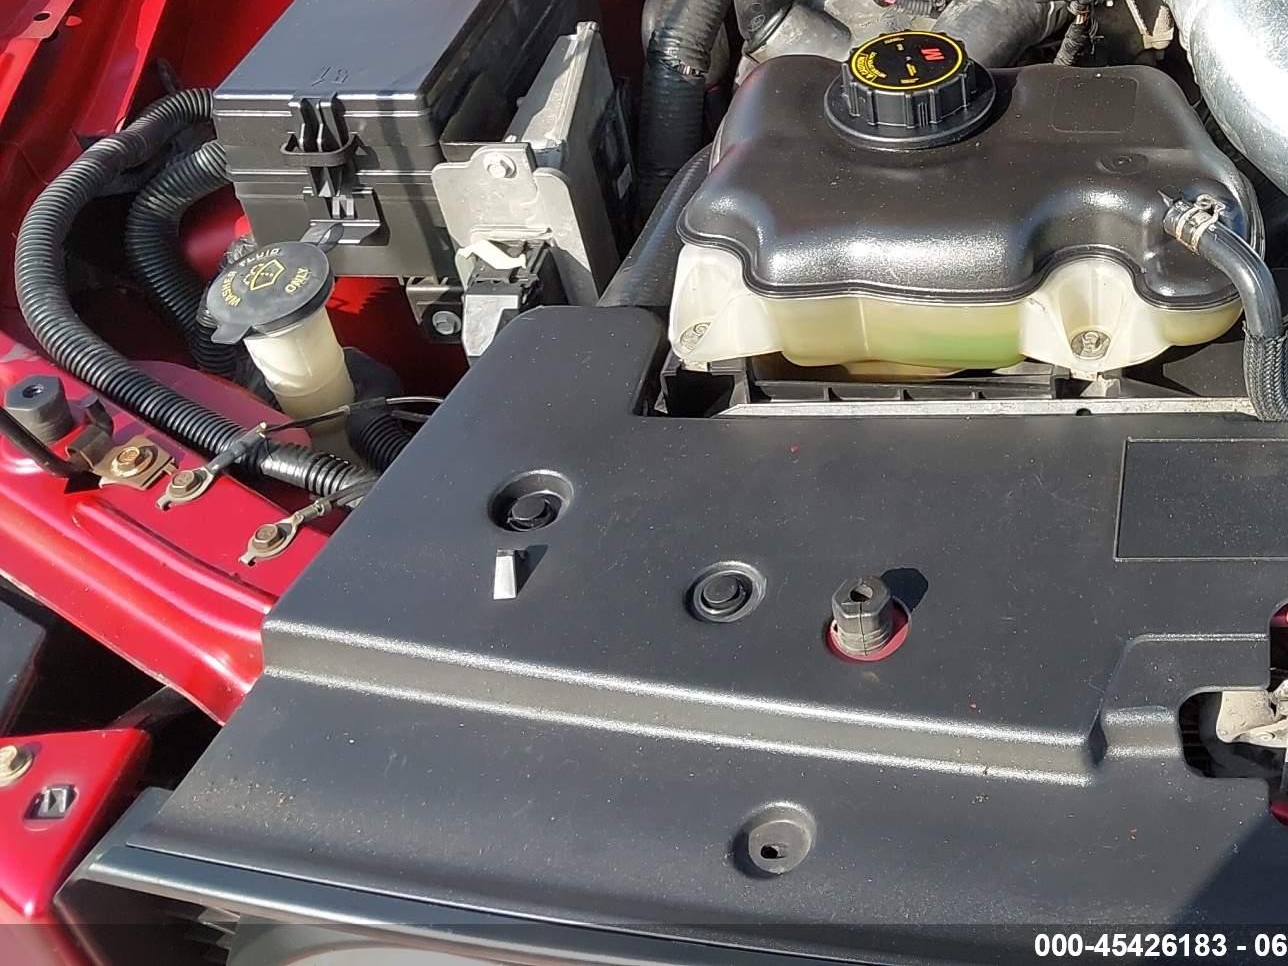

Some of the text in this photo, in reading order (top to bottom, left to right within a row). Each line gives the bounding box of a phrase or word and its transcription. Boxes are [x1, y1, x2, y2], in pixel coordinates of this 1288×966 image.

[221, 248, 310, 307] WASHER FLUID ONLY
